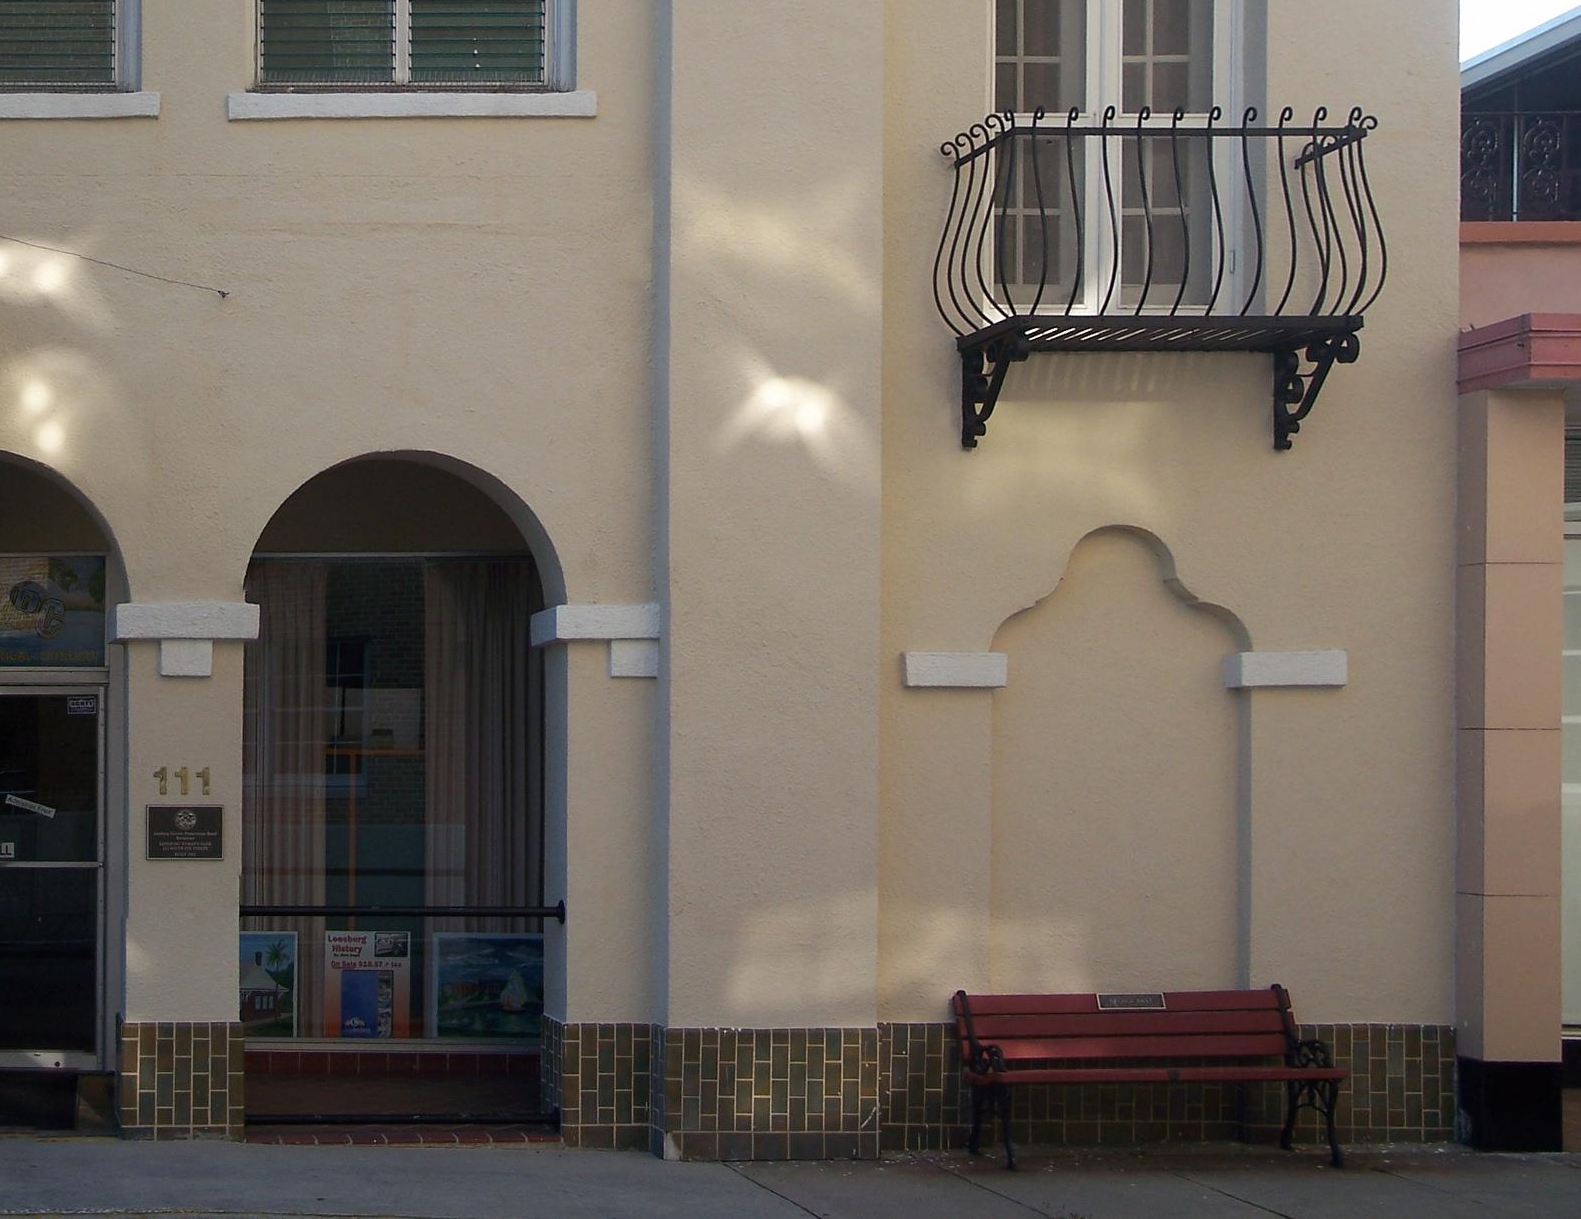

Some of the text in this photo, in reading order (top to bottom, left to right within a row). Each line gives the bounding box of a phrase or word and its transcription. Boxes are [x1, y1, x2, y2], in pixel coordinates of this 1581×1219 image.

[153, 765, 211, 796] 111
[327, 934, 368, 945] Leesburg
[332, 945, 363, 954] History
